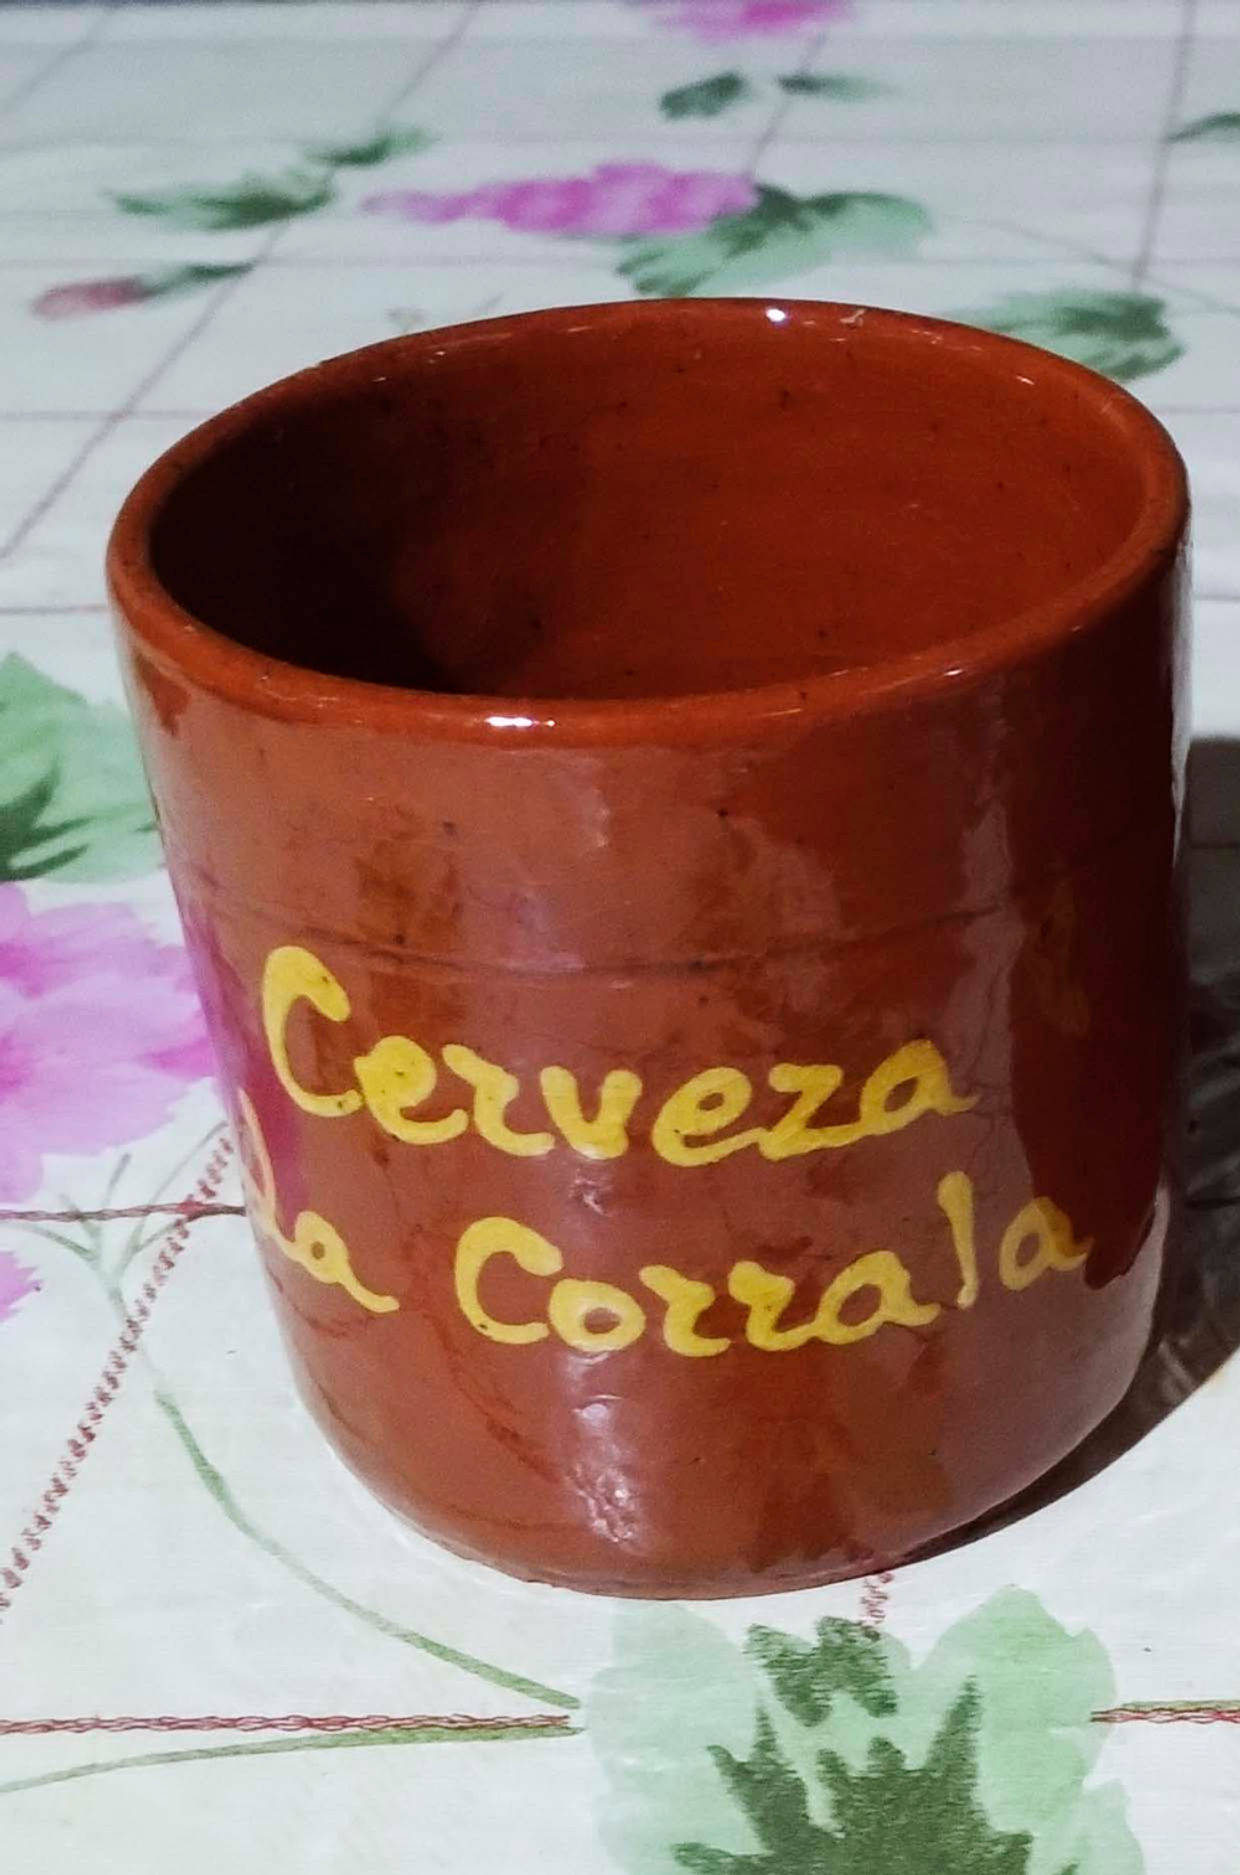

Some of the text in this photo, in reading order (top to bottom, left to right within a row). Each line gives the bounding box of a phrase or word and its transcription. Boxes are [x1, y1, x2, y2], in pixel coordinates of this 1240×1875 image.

[261, 945, 979, 1167] Cerveza
[238, 1086, 1094, 1358] La Corrala
